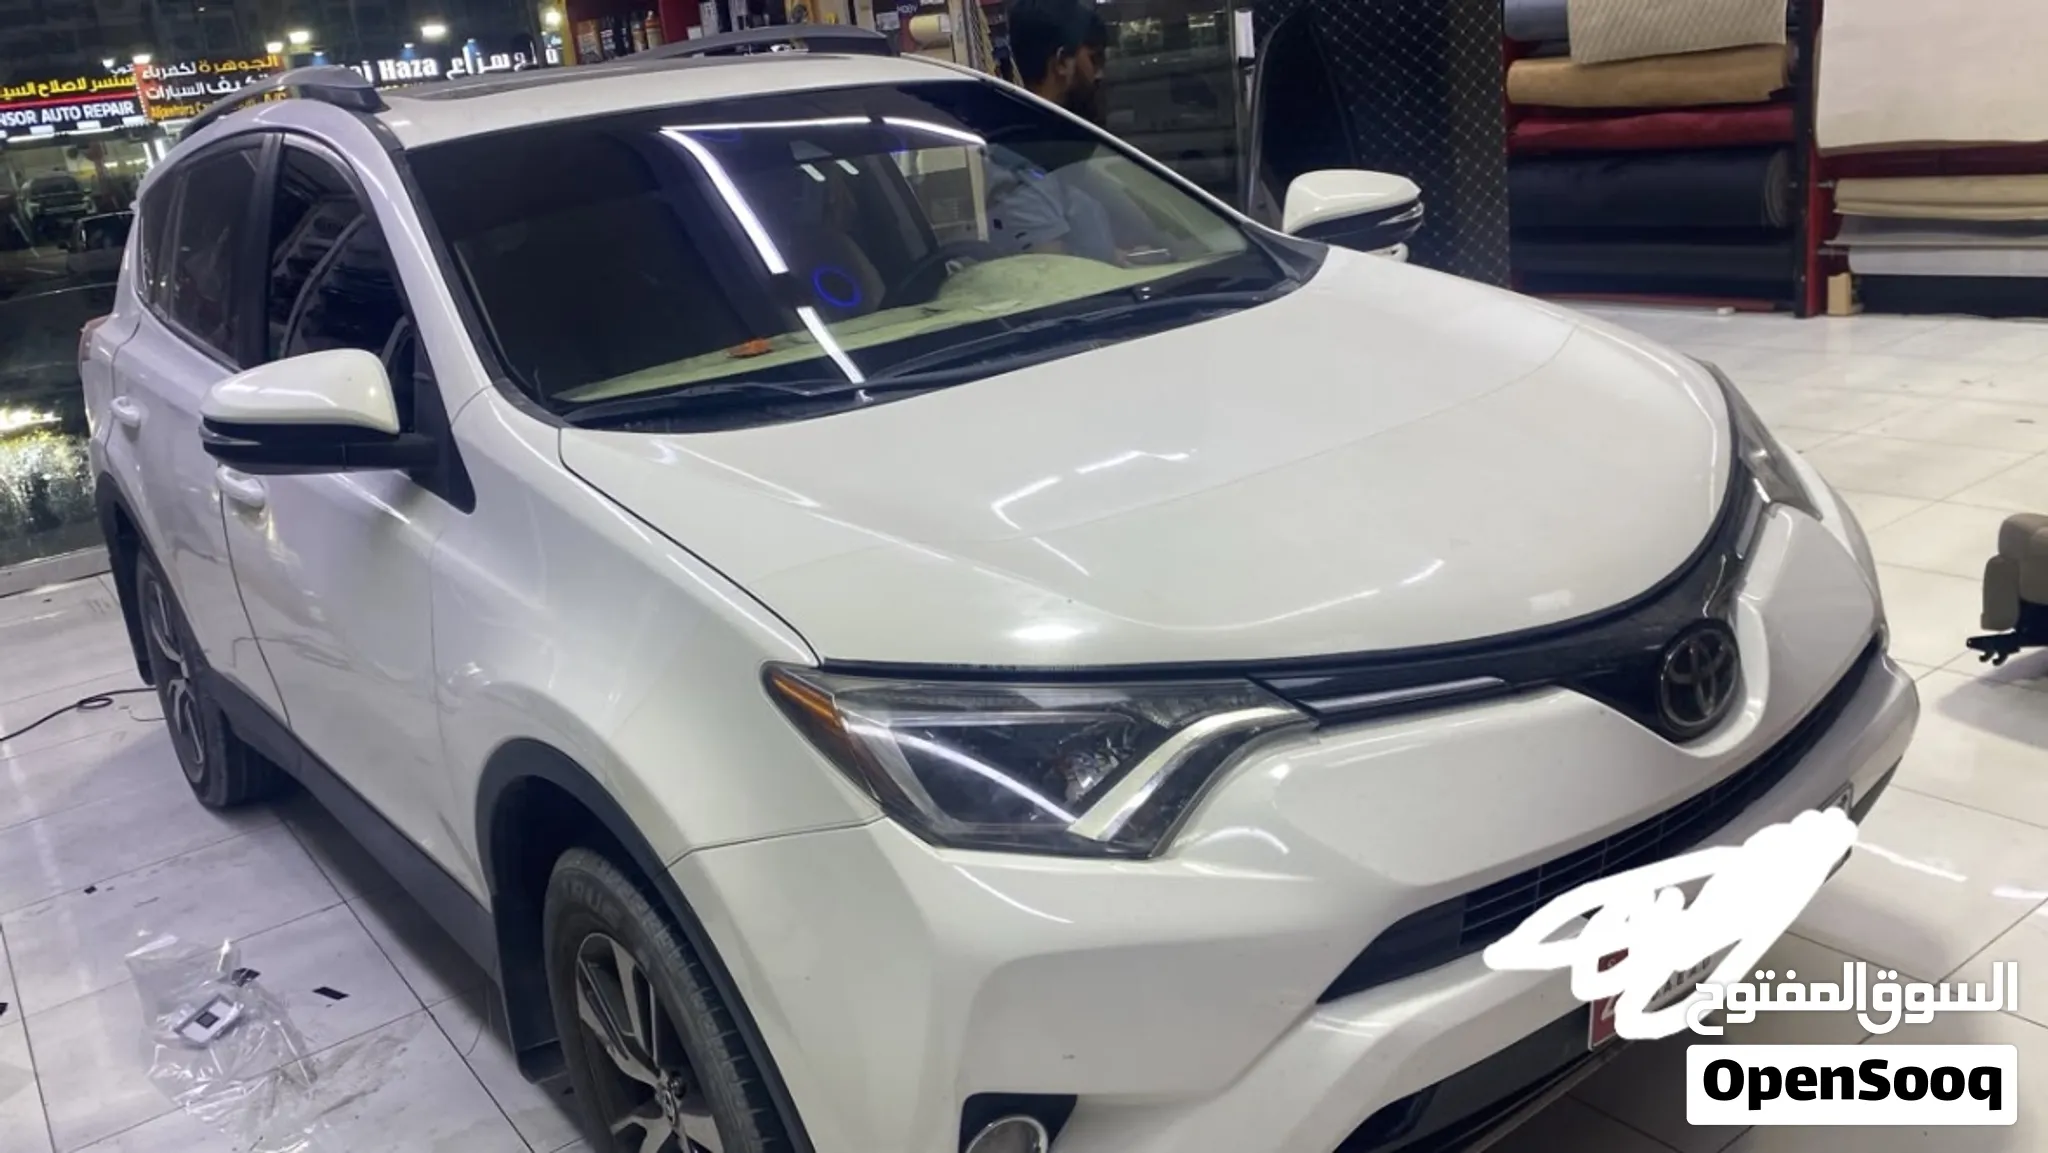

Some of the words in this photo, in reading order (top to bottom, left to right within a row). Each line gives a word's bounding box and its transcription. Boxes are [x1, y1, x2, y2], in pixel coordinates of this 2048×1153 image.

[199, 54, 278, 74] الجوهرة
[377, 58, 438, 81] Haza
[145, 82, 205, 99] السيارات
[41, 106, 82, 123] AUTO
[82, 101, 135, 119] REPAIR
